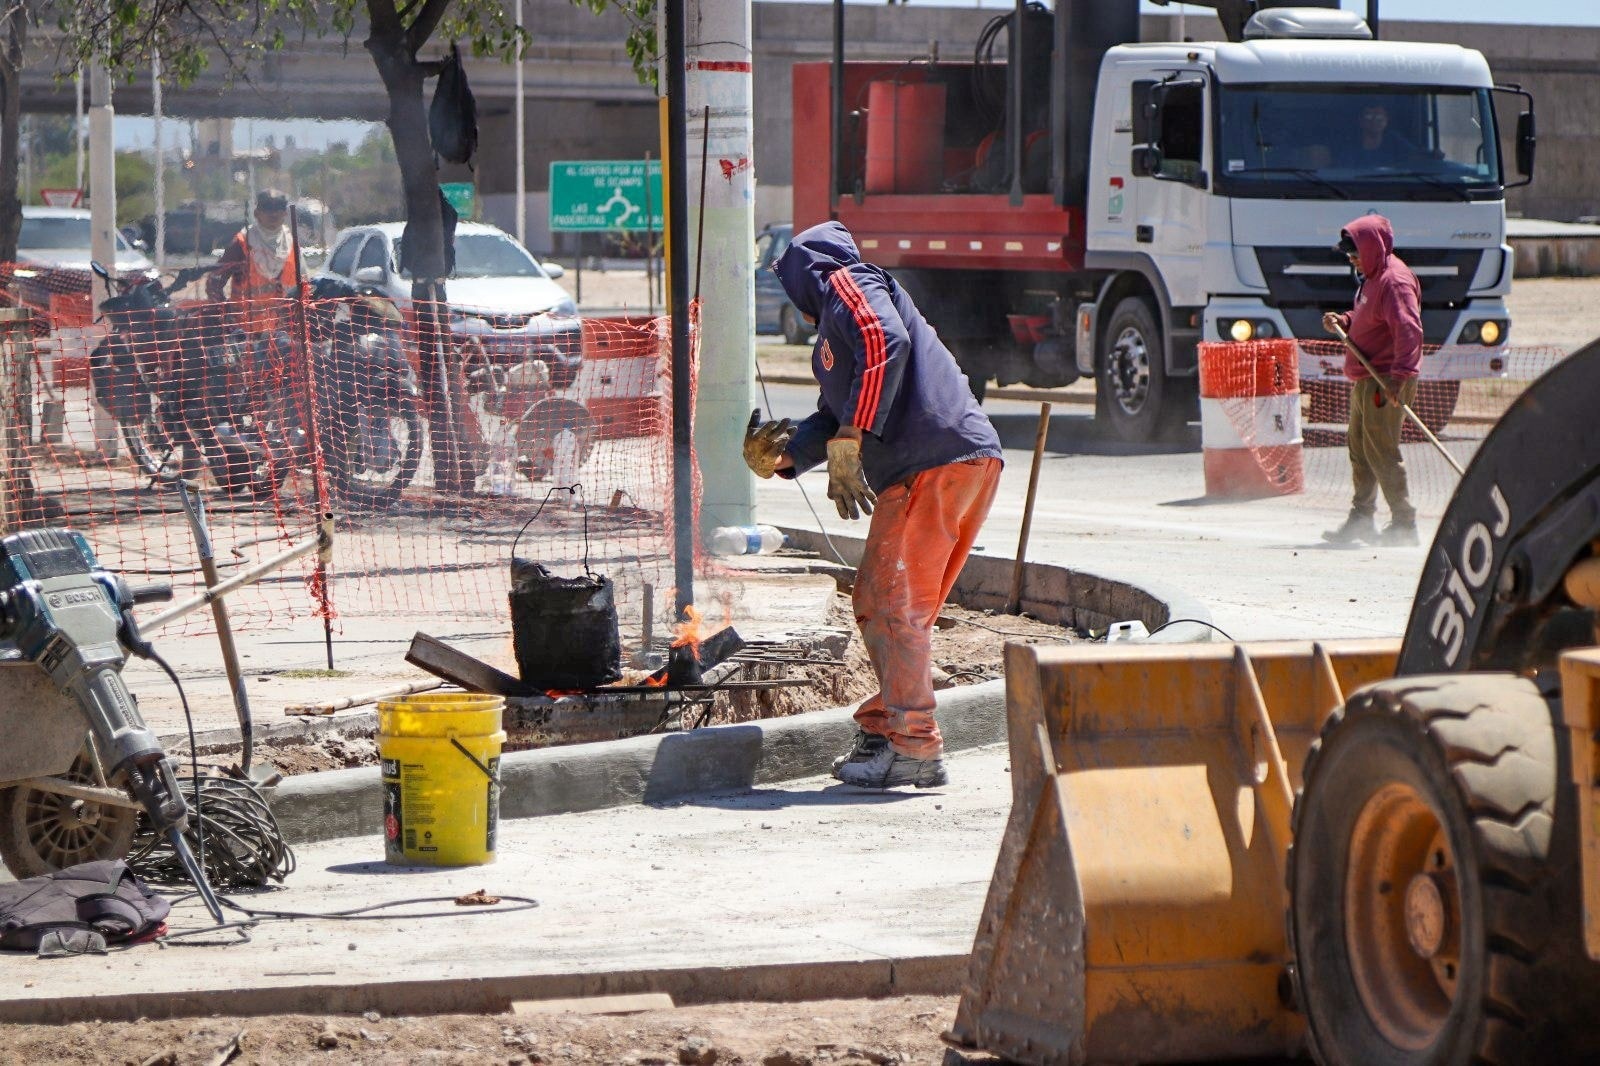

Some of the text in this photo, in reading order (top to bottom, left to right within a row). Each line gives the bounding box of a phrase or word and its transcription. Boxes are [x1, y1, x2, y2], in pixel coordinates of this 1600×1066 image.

[566, 167, 576, 177] AL
[579, 166, 610, 176] CENTRO
[614, 166, 631, 176] POR
[594, 177, 605, 187] DE
[571, 203, 588, 213] LAS
[1431, 485, 1510, 667] 310J
[65, 591, 101, 604] BOSCH
